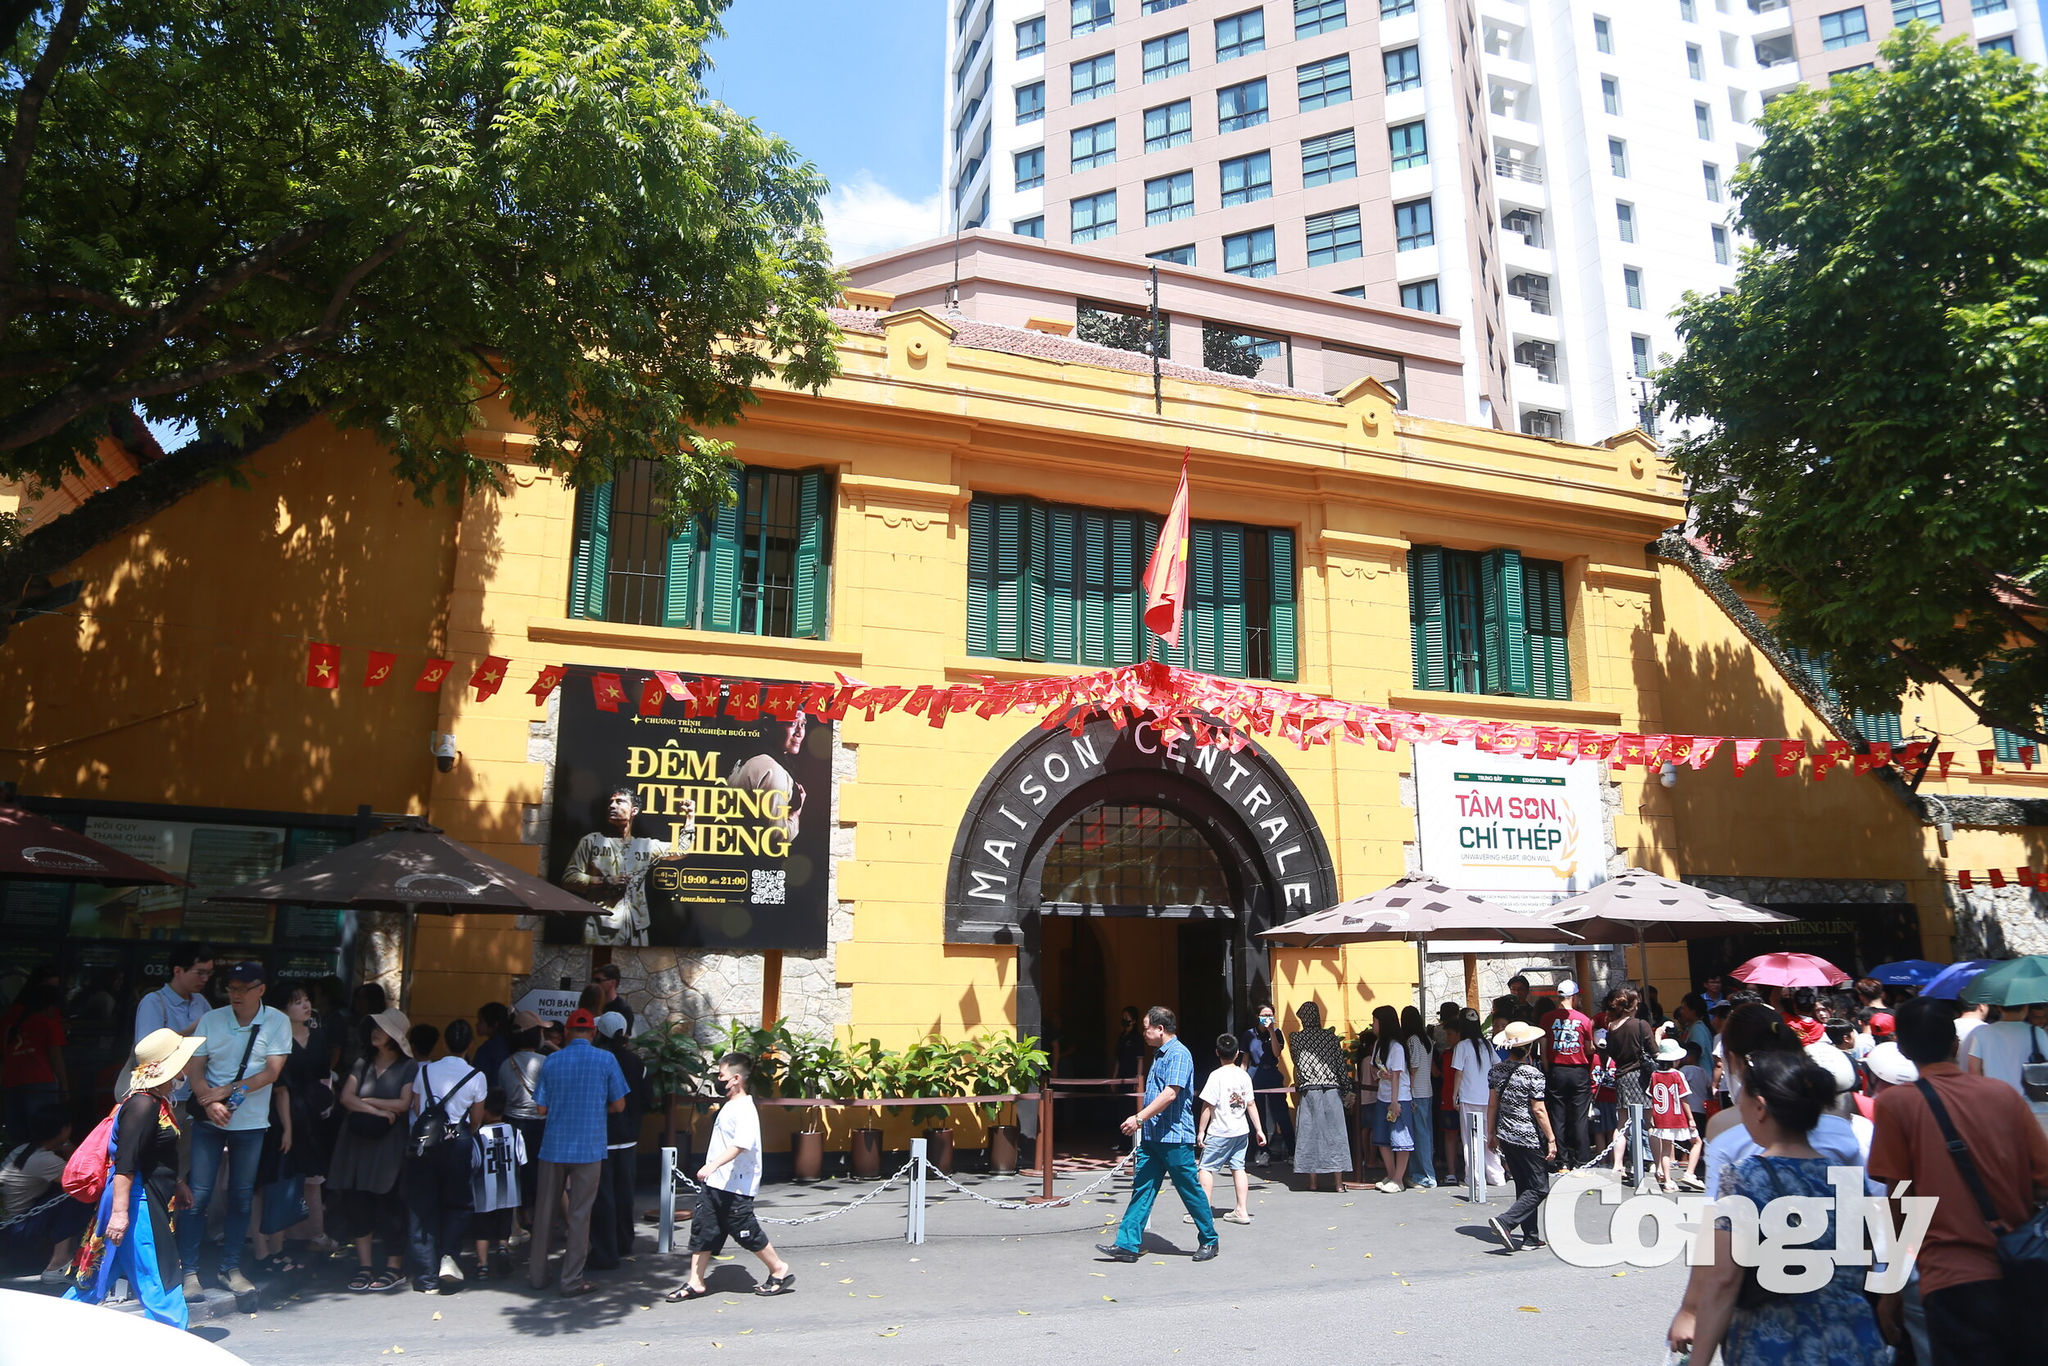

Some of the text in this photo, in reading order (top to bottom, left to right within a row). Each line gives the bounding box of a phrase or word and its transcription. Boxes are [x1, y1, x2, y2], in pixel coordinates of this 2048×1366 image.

[626, 738, 721, 783] ĐÊM
[637, 777, 792, 822] THIÊNG
[967, 721, 1312, 907] MAISON CENTRALE
[1455, 789, 1503, 818] TÂM
[1459, 821, 1562, 850] CHÍ THÉP
[1461, 853, 1500, 861] UNWAVERING
[682, 875, 708, 884] 19:00
[720, 876, 746, 886] 21:00
[538, 1007, 562, 1017] Ticket
[557, 998, 576, 1008] BÁN
[1653, 1082, 1682, 1115] 91
[486, 1144, 512, 1174] 24
